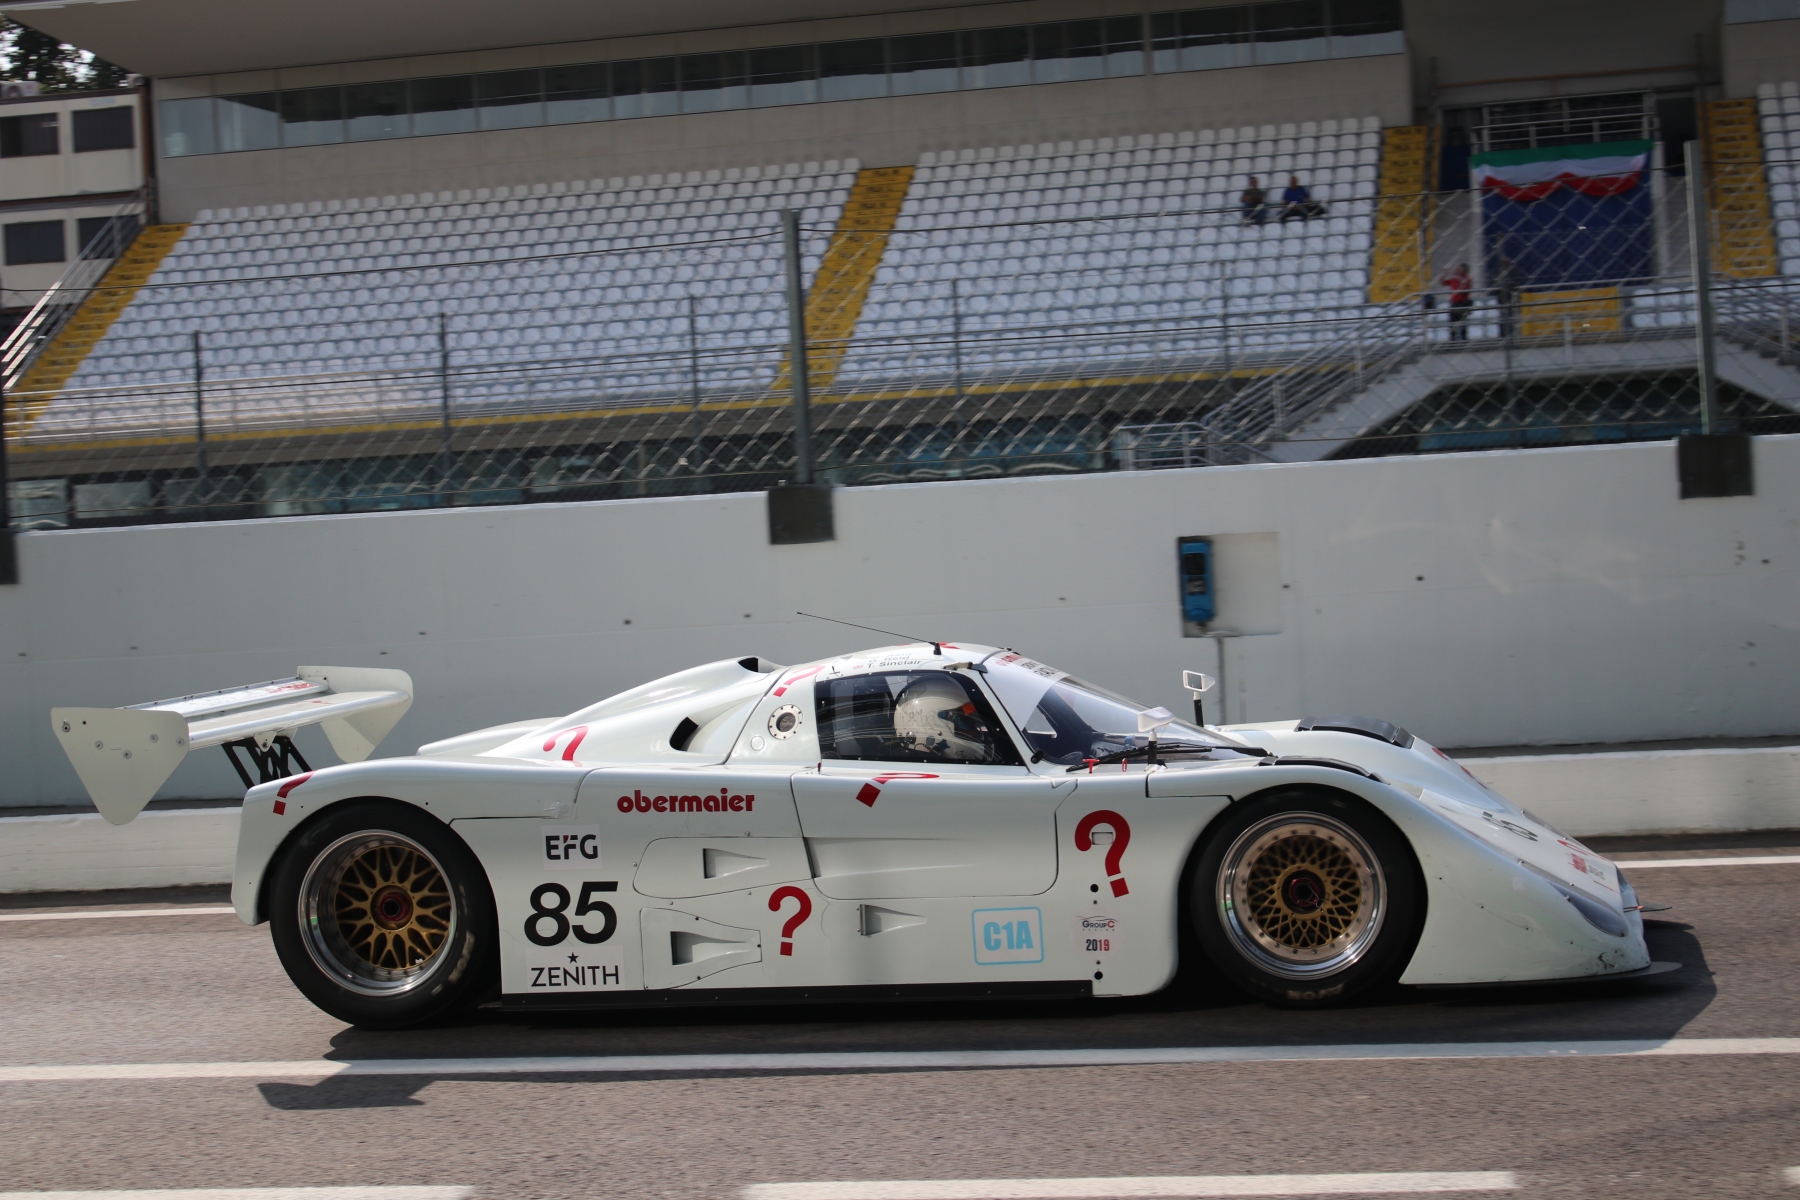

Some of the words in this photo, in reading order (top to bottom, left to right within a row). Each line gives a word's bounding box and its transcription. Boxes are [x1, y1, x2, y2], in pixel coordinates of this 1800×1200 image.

[617, 787, 755, 813] obermaier
[545, 834, 599, 860] EFG
[524, 881, 619, 947] 85
[983, 921, 1034, 951] C1A
[1086, 939, 1110, 951] 2019
[531, 965, 620, 987] ZENITH
